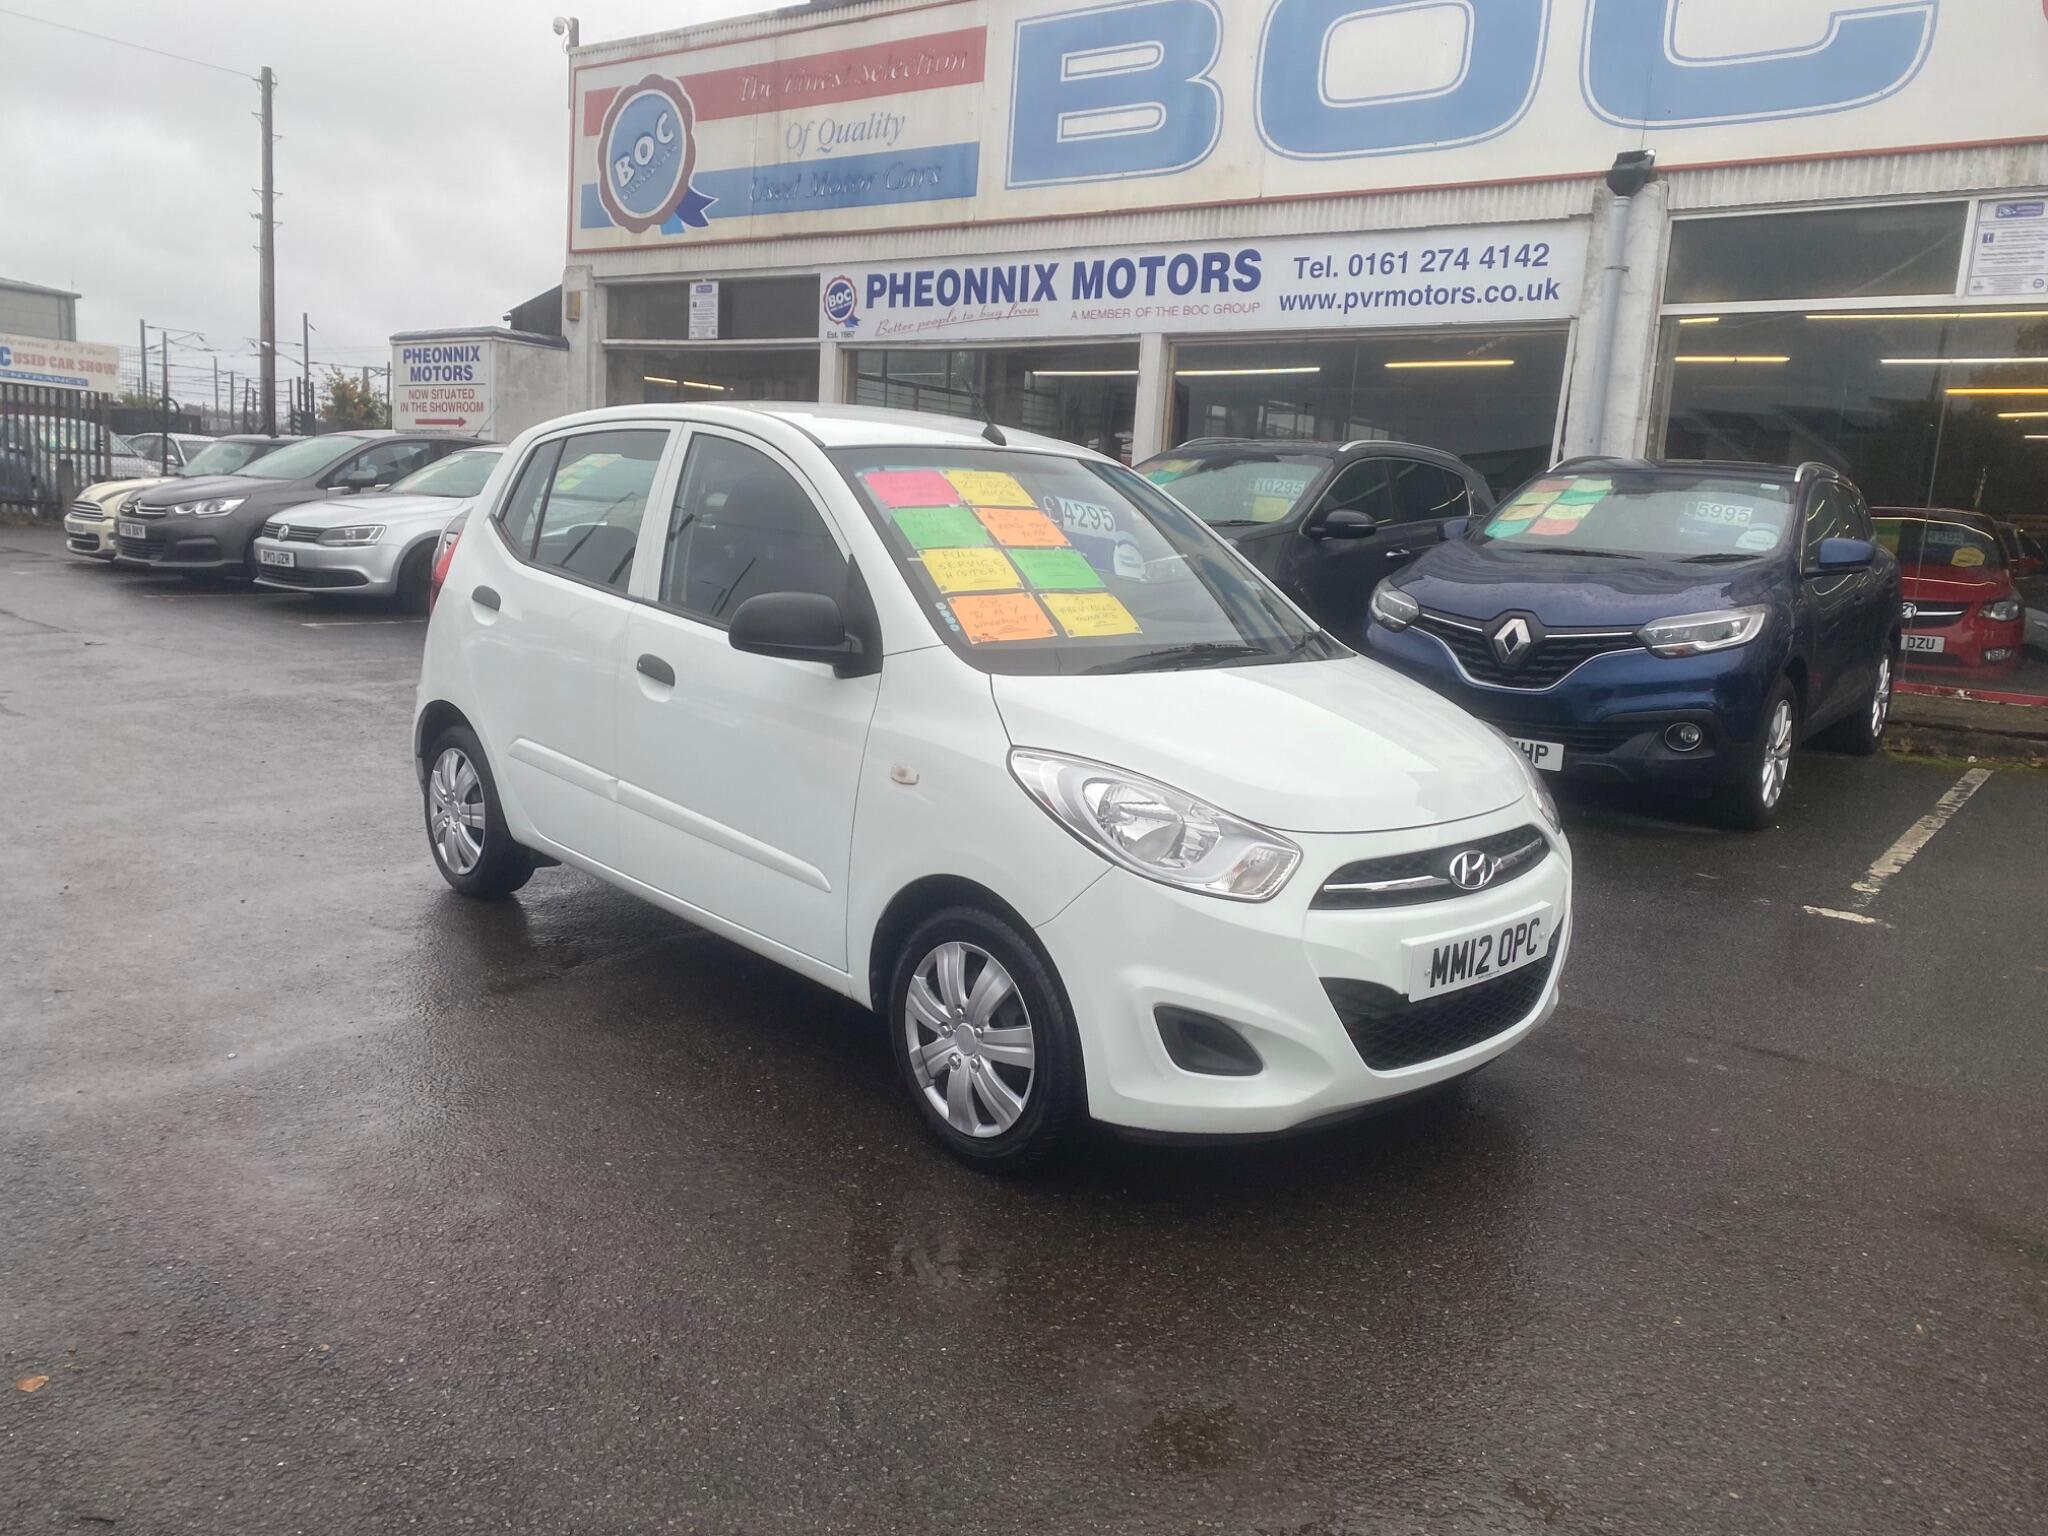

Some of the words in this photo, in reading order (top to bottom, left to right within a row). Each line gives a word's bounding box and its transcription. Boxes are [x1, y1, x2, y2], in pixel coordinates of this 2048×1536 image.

[614, 112, 675, 188] BOC
[786, 119, 815, 157] Of
[816, 111, 907, 152] Quality
[884, 160, 943, 192] Cars
[1293, 255, 1339, 280] Tel.
[1348, 250, 1409, 277] 0161
[1420, 247, 1470, 273] 274
[1479, 242, 1551, 271] 4142
[866, 262, 1060, 309] PHEONNIX
[1071, 248, 1263, 301] MOTORS
[828, 288, 852, 308] BOC
[1070, 310, 1079, 320] A
[1081, 308, 1131, 320] MEMBER
[1135, 306, 1152, 318] OF
[1155, 305, 1179, 317] THE
[1183, 304, 1210, 316] BOC
[1213, 301, 1261, 315] GROUP
[1279, 277, 1561, 315] www.pvrmotors.co.uk
[875, 319, 913, 337] Better
[917, 309, 958, 332] people
[962, 310, 975, 320] to
[979, 305, 1005, 321] buy
[1007, 302, 1040, 320] from
[13, 351, 46, 366] USED
[48, 356, 75, 371] CAR
[78, 359, 117, 375] SHOW
[402, 345, 481, 364] PHEONNIX
[410, 364, 474, 382] MOTORS
[400, 402, 409, 413] IN
[410, 401, 428, 413] THE
[429, 401, 484, 413] SHOWROOM
[408, 389, 430, 401] NOW
[431, 388, 475, 400] SITUATED
[1042, 495, 1115, 532] £4295
[1430, 934, 1493, 989] MM12
[1497, 917, 1541, 968] OPC
